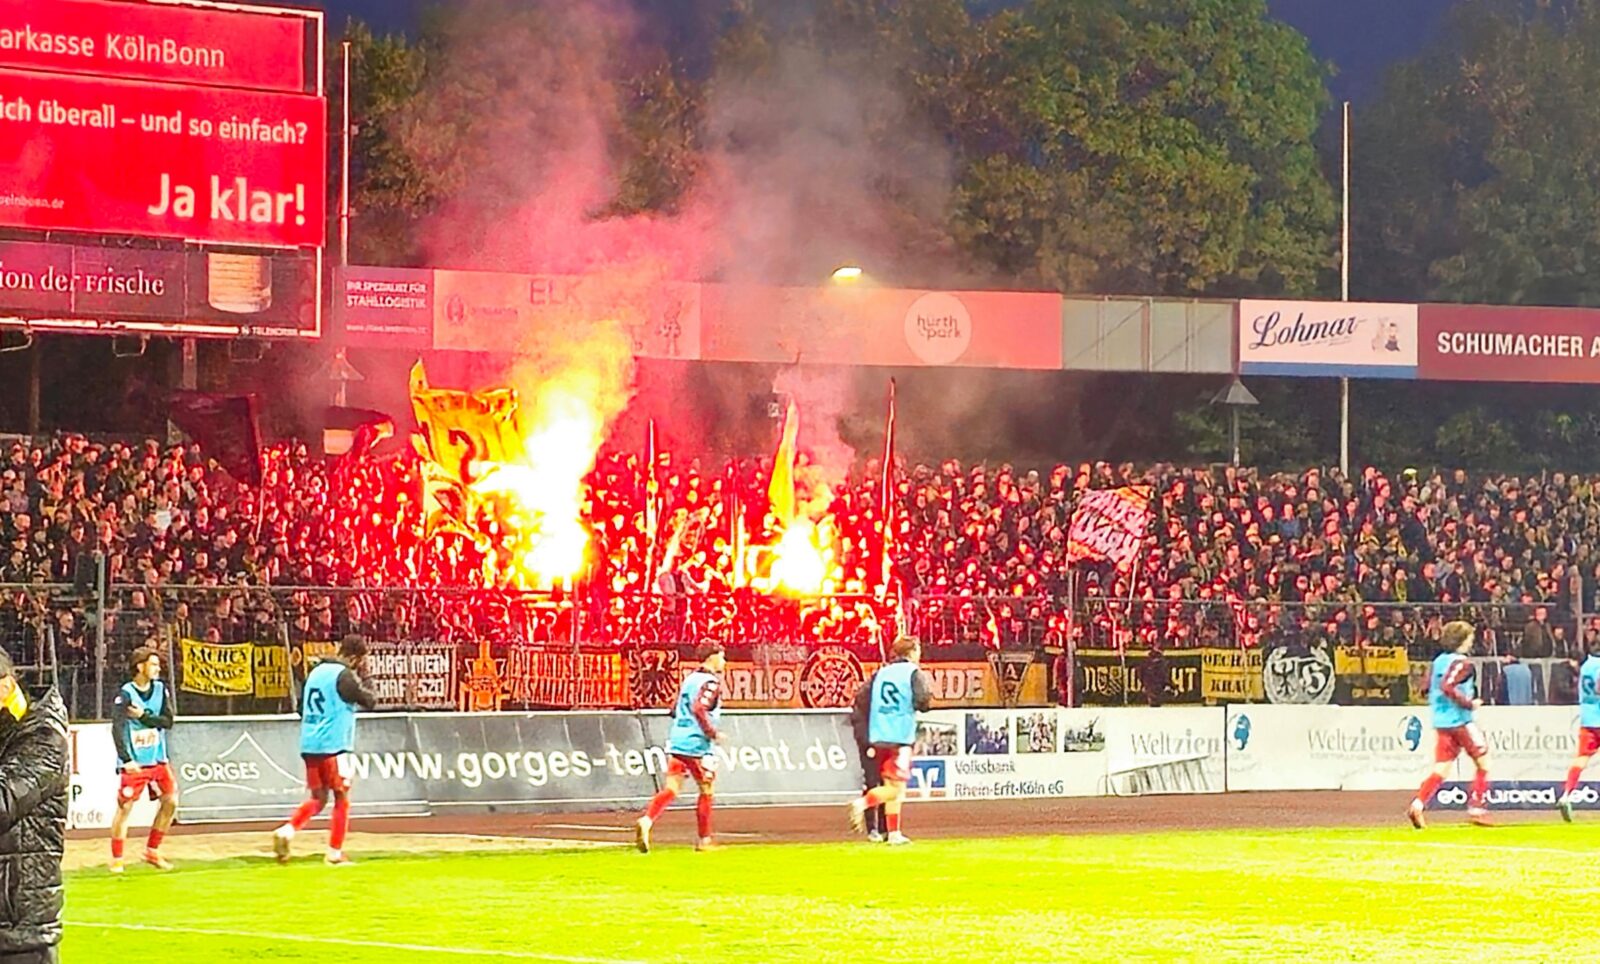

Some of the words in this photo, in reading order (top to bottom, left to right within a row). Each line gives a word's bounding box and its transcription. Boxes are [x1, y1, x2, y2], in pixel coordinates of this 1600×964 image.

[0, 24, 94, 57] arkasse
[106, 33, 225, 68] KölnBonn
[38, 99, 115, 129] überall
[141, 110, 182, 135] und
[189, 117, 212, 137] so
[219, 115, 308, 144] einfach?
[148, 173, 195, 217] Ja
[210, 175, 306, 226] klar!
[40, 265, 81, 292] der
[346, 295, 427, 309] STAHLLOGISTIK
[1249, 312, 1366, 350] Lohmar
[1437, 331, 1584, 358] SCHUMACHER
[1131, 728, 1219, 755] Weltzien
[1308, 726, 1395, 752] Weltzien
[180, 762, 260, 782] GORGES
[954, 758, 1016, 774] Volksbank
[1048, 780, 1064, 795] eG
